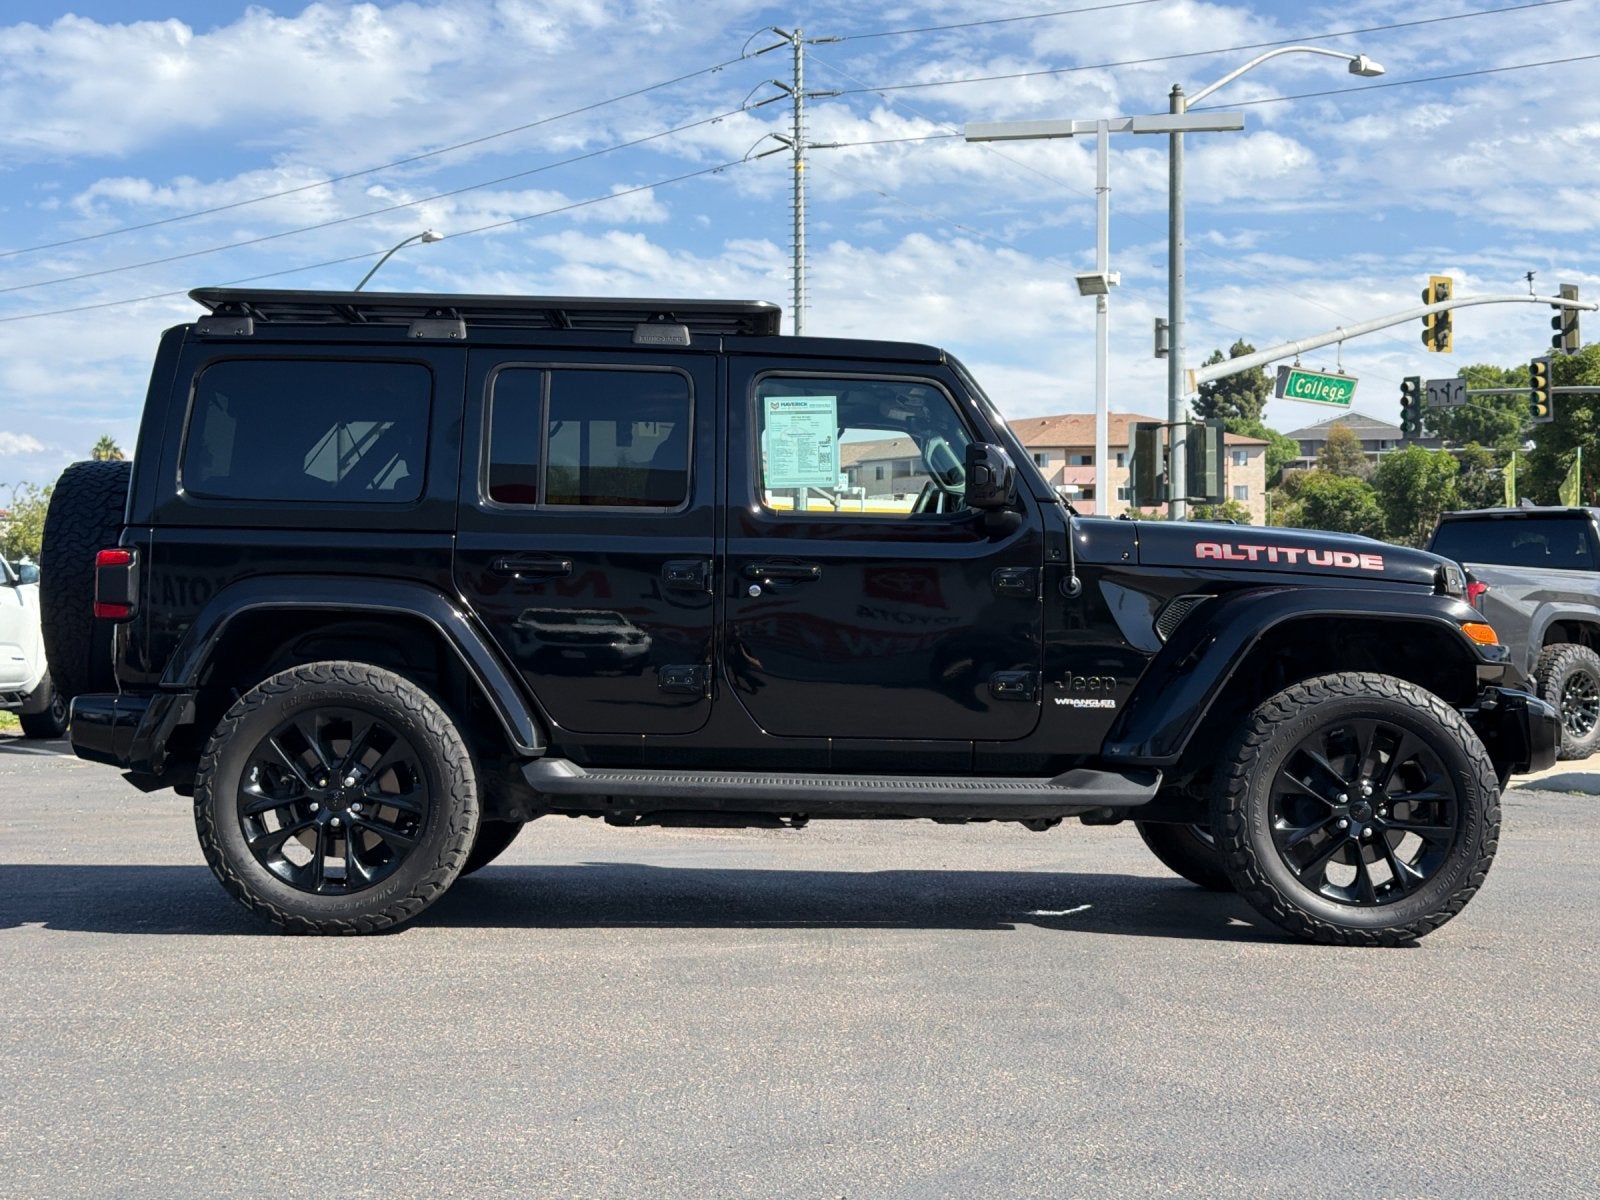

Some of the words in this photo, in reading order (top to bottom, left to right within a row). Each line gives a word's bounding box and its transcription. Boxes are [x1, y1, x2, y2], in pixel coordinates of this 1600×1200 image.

[1296, 378, 1345, 401] College
[1195, 542, 1385, 571] ALTITUDE
[1054, 670, 1117, 697] Jeep
[1054, 698, 1116, 706] WRANGLER
